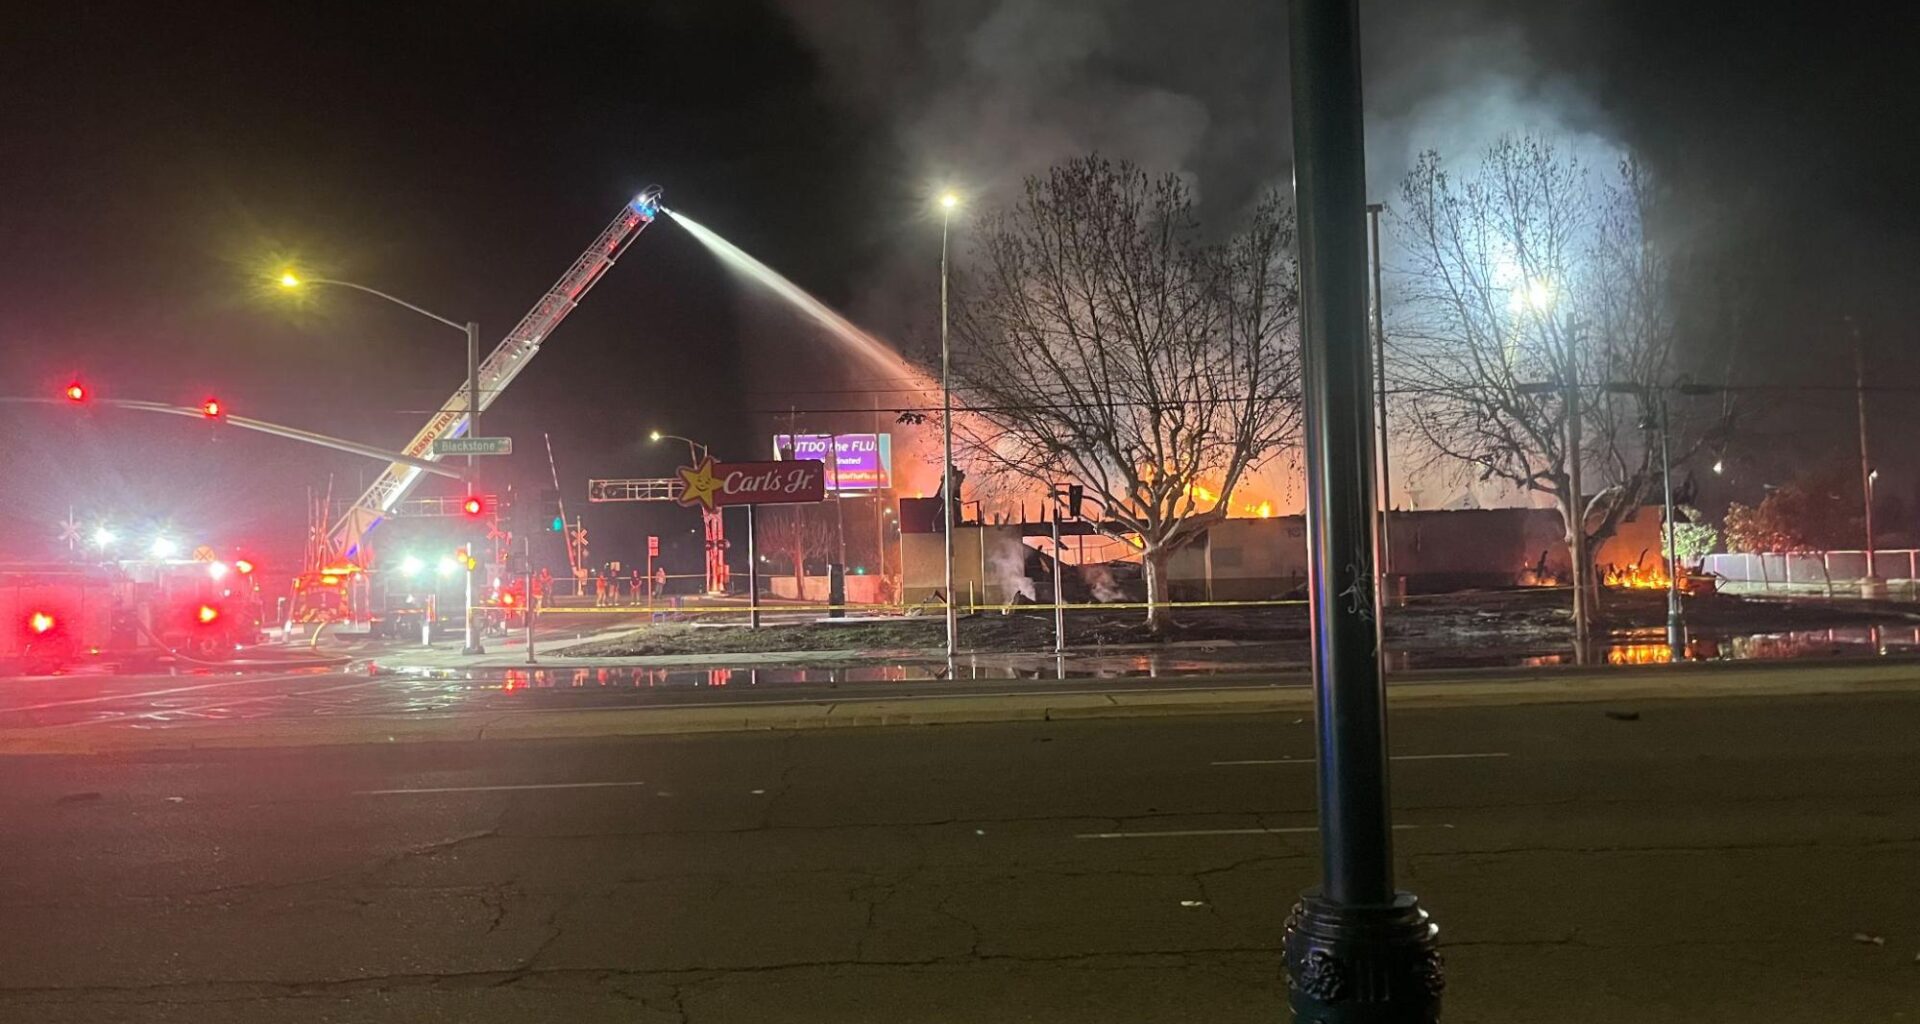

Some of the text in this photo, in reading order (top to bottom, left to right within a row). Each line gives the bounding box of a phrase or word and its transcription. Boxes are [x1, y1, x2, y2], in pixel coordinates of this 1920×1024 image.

[434, 412, 455, 431] FIRE
[441, 440, 495, 452] Blackstone
[723, 469, 814, 495] Carl's Jr.
